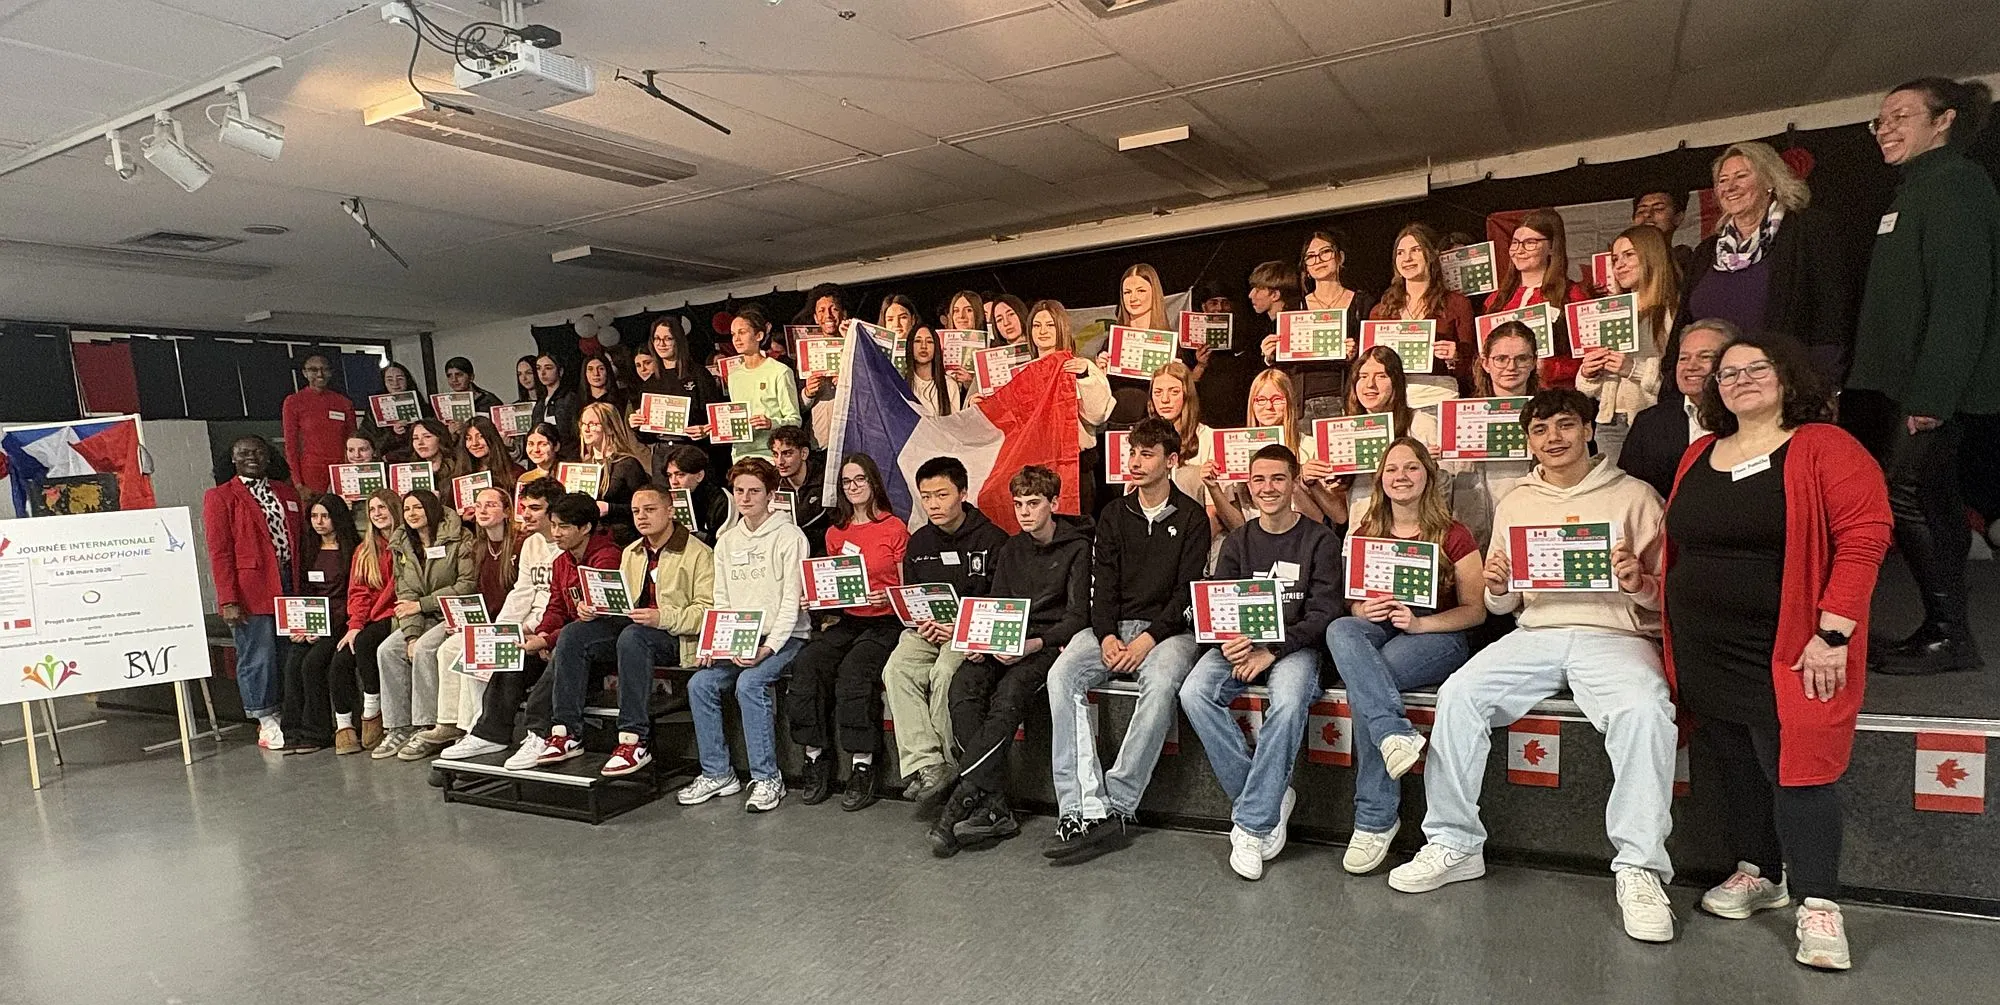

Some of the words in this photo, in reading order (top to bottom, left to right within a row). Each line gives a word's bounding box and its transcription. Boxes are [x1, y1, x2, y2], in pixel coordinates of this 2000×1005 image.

[17, 543, 67, 555] JOURNÉE
[69, 536, 156, 551] INTERNATIONALE
[43, 556, 60, 565] LA
[62, 548, 152, 563] FRANCOPHONIE
[124, 645, 177, 680] BVS
